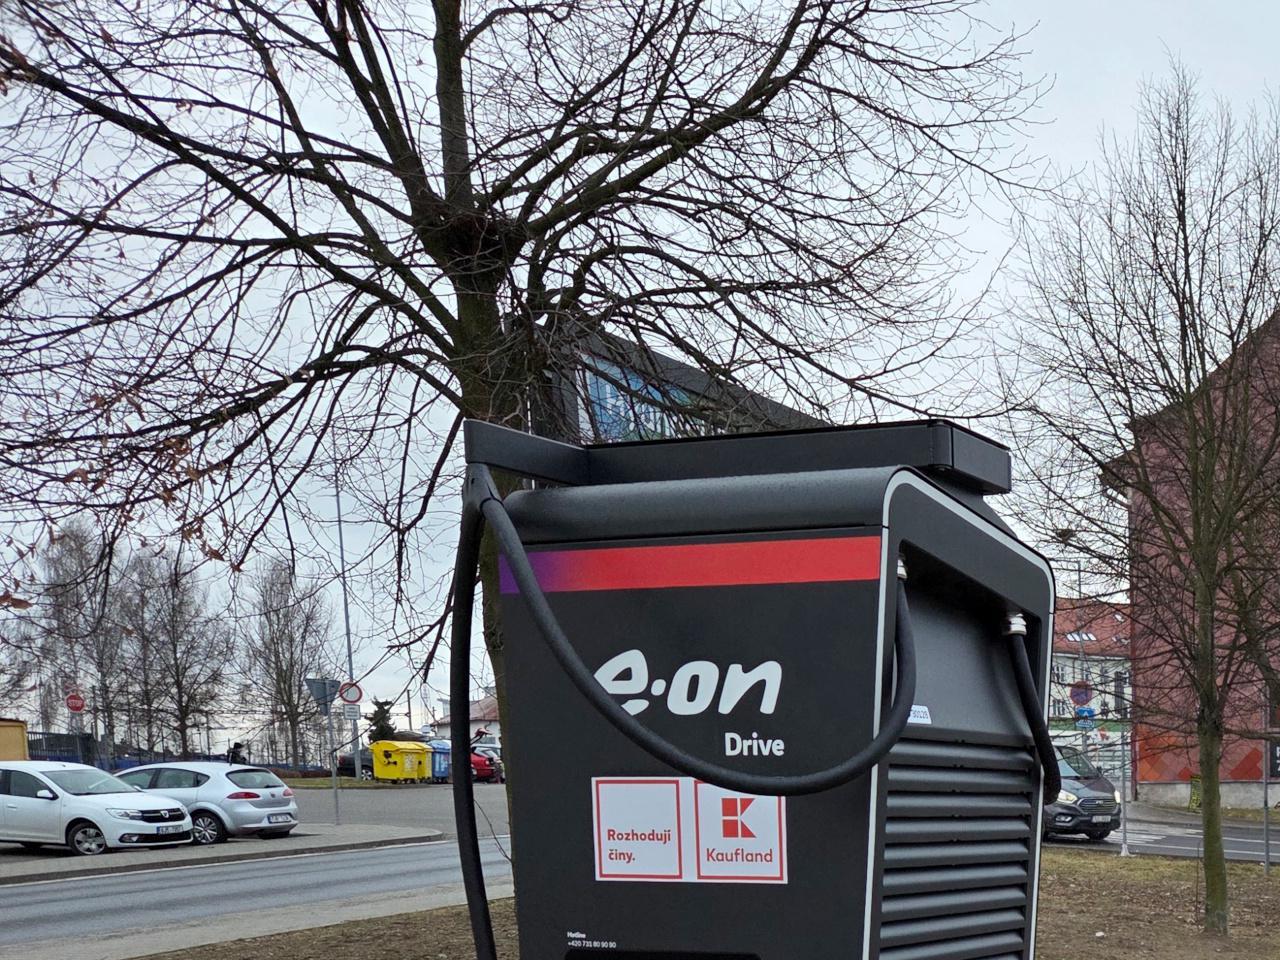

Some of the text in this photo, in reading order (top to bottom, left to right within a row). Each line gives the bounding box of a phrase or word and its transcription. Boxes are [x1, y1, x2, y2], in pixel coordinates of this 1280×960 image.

[725, 732, 785, 757] Drive
[606, 828, 671, 844] Rozhodují
[608, 848, 636, 864] činy.
[706, 847, 773, 863] Kaufland
